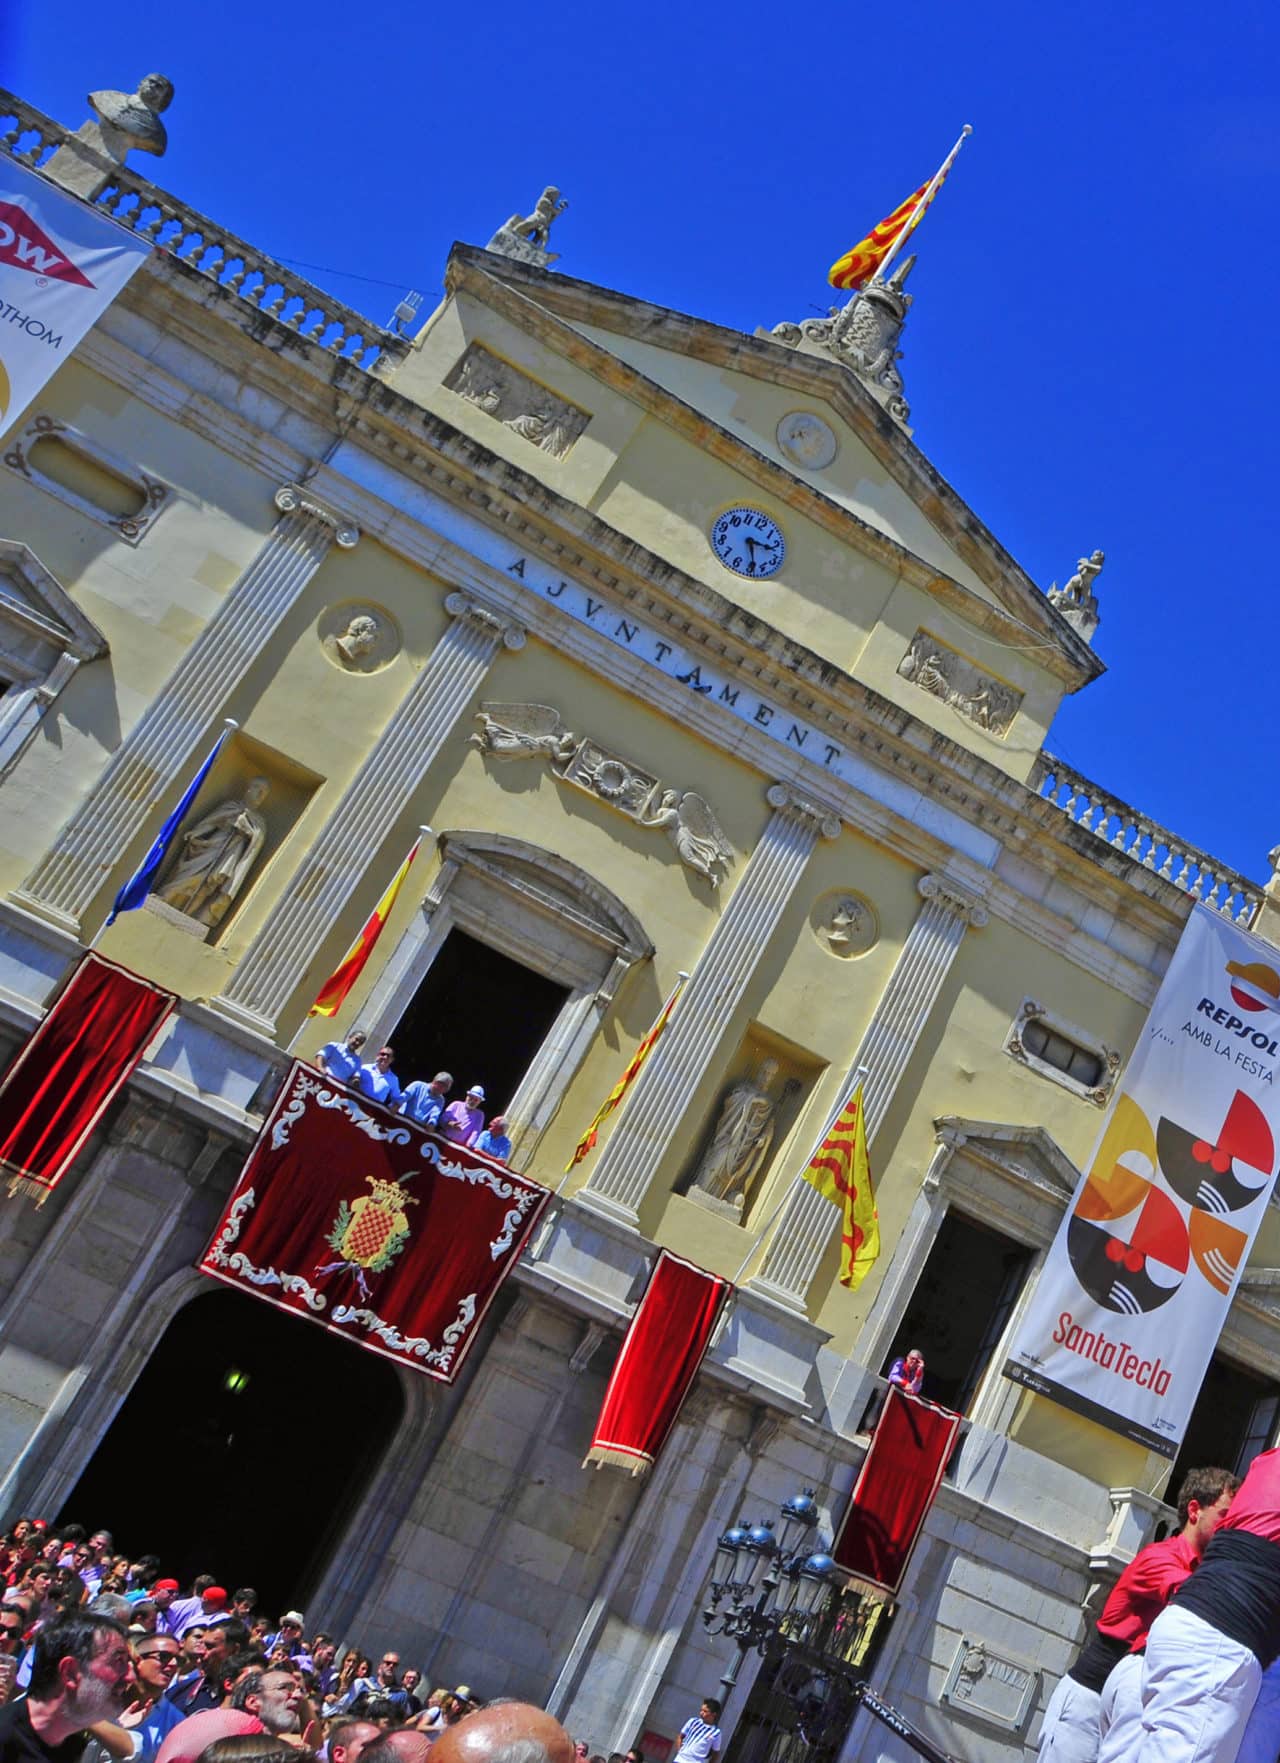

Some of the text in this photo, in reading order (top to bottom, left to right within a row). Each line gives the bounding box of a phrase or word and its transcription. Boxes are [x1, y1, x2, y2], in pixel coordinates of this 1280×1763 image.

[0, 301, 63, 349] THOM
[729, 514, 742, 528] 10
[743, 513, 754, 526] 11
[754, 518, 768, 531] 12
[718, 521, 729, 533] 9
[717, 534, 727, 546] 8
[766, 529, 774, 540] 1
[723, 546, 733, 558] 7
[732, 556, 743, 568] 6
[768, 553, 779, 566] 3
[759, 561, 768, 573] 4
[1196, 997, 1280, 1057] REPSOL
[1181, 1020, 1213, 1047] AMB
[1214, 1039, 1231, 1061] LA
[1233, 1051, 1274, 1086] FESTA
[1053, 1311, 1172, 1397] SantaTecla
